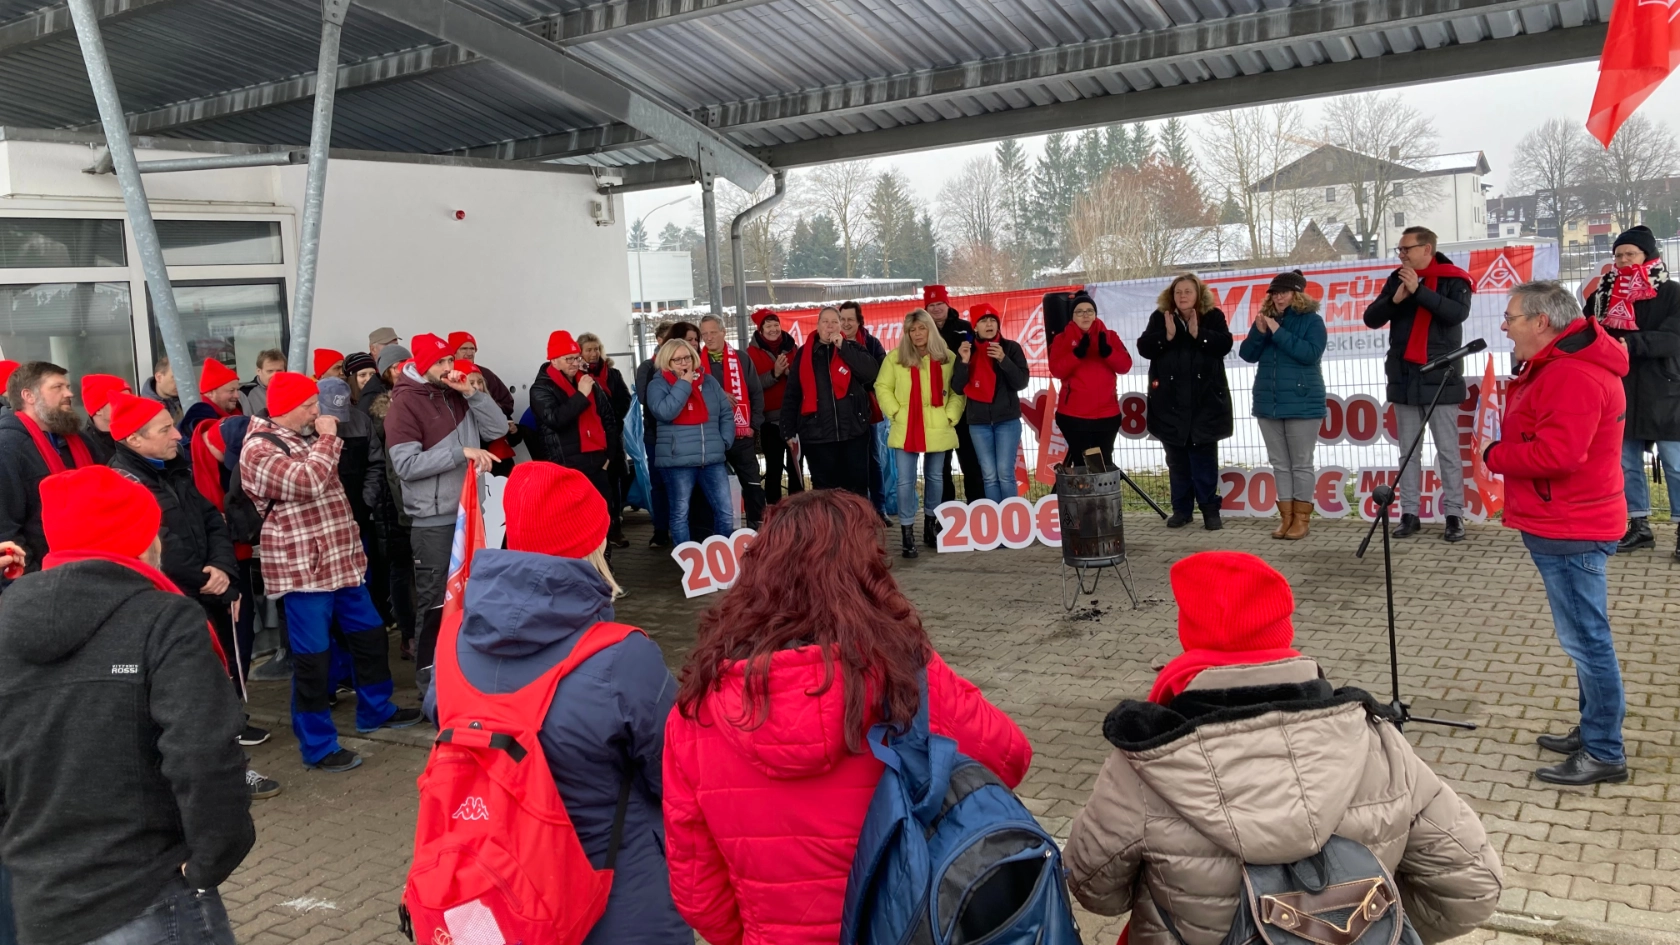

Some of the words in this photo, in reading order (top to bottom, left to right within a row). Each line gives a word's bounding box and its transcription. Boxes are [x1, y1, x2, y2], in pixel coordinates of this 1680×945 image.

[1326, 333, 1386, 352] ekleid
[1220, 471, 1344, 512] 20€
[941, 501, 1061, 547] 200€
